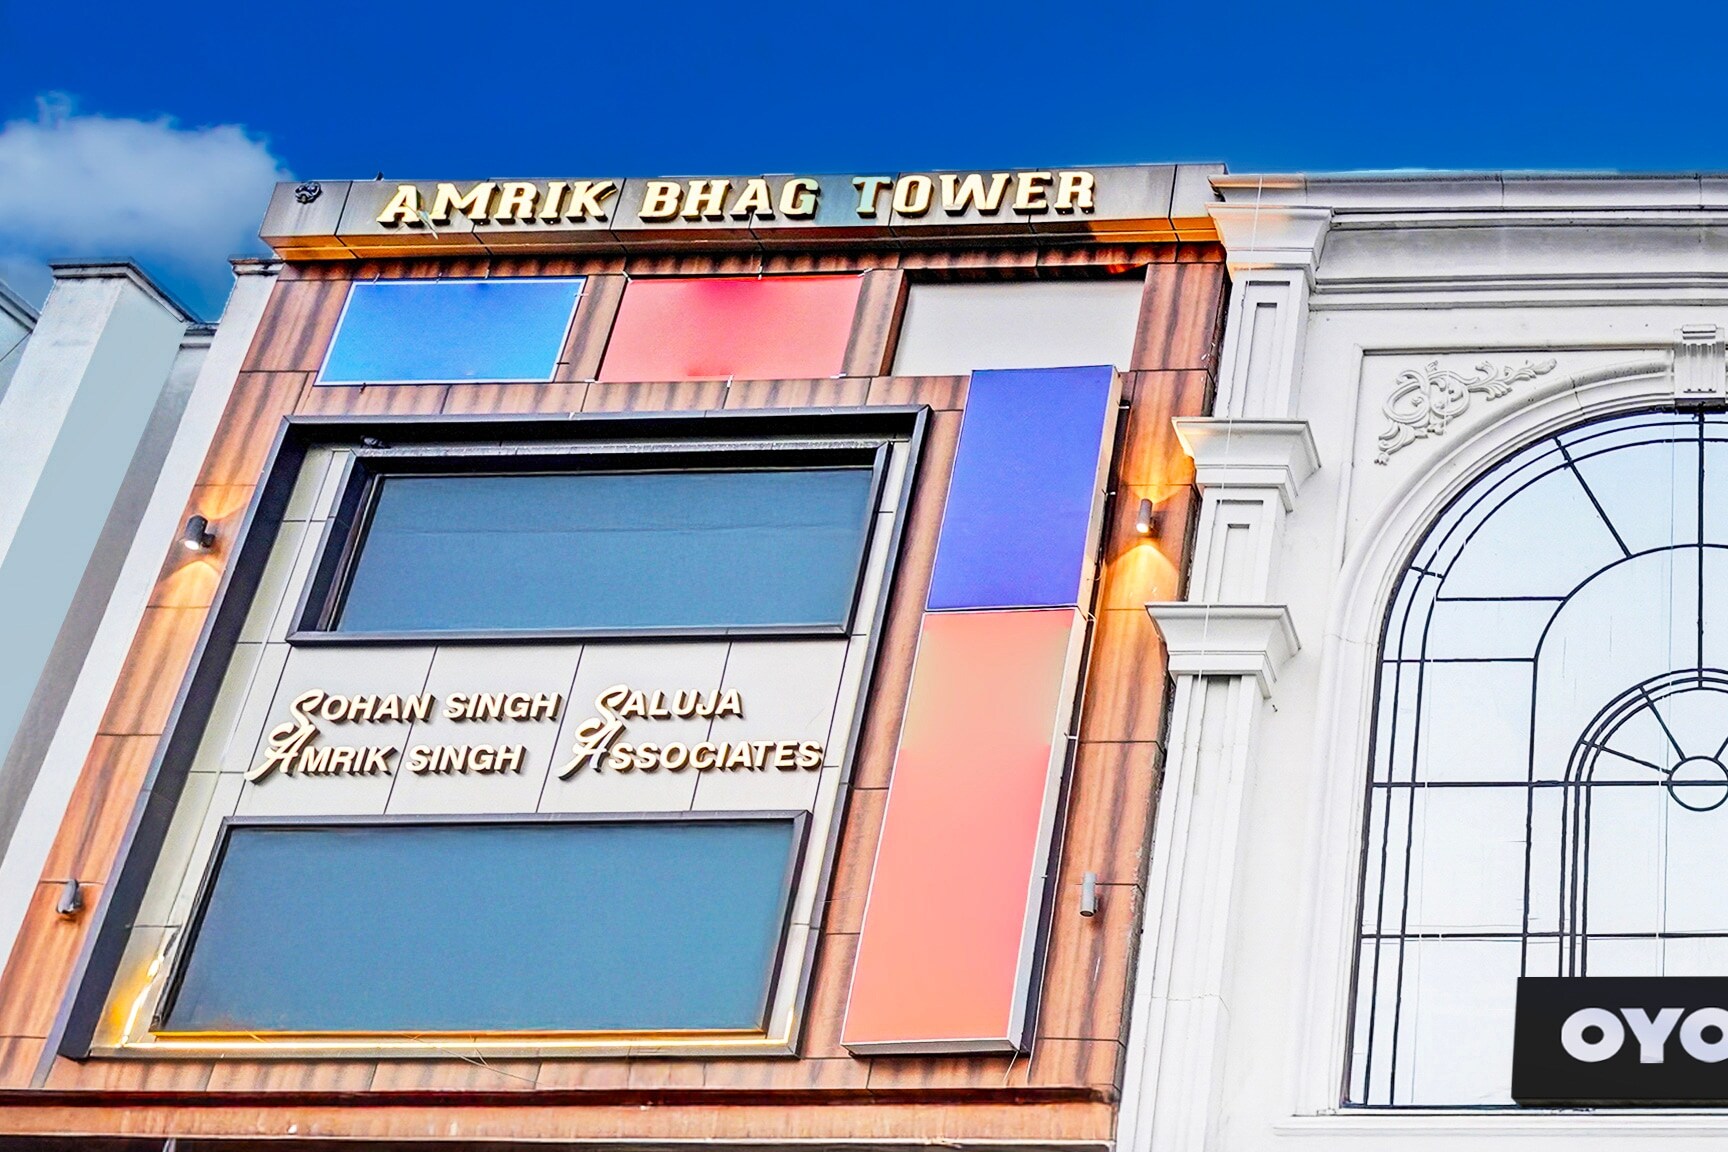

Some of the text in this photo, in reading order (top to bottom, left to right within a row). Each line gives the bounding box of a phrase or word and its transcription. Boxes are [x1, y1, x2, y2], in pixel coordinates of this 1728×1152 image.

[376, 170, 1096, 225] AMRIK BHAG TOWER
[290, 684, 744, 728] SOHAN SINGH SALUJA
[243, 717, 824, 783] AMRIK SINGH ASSOCIATES
